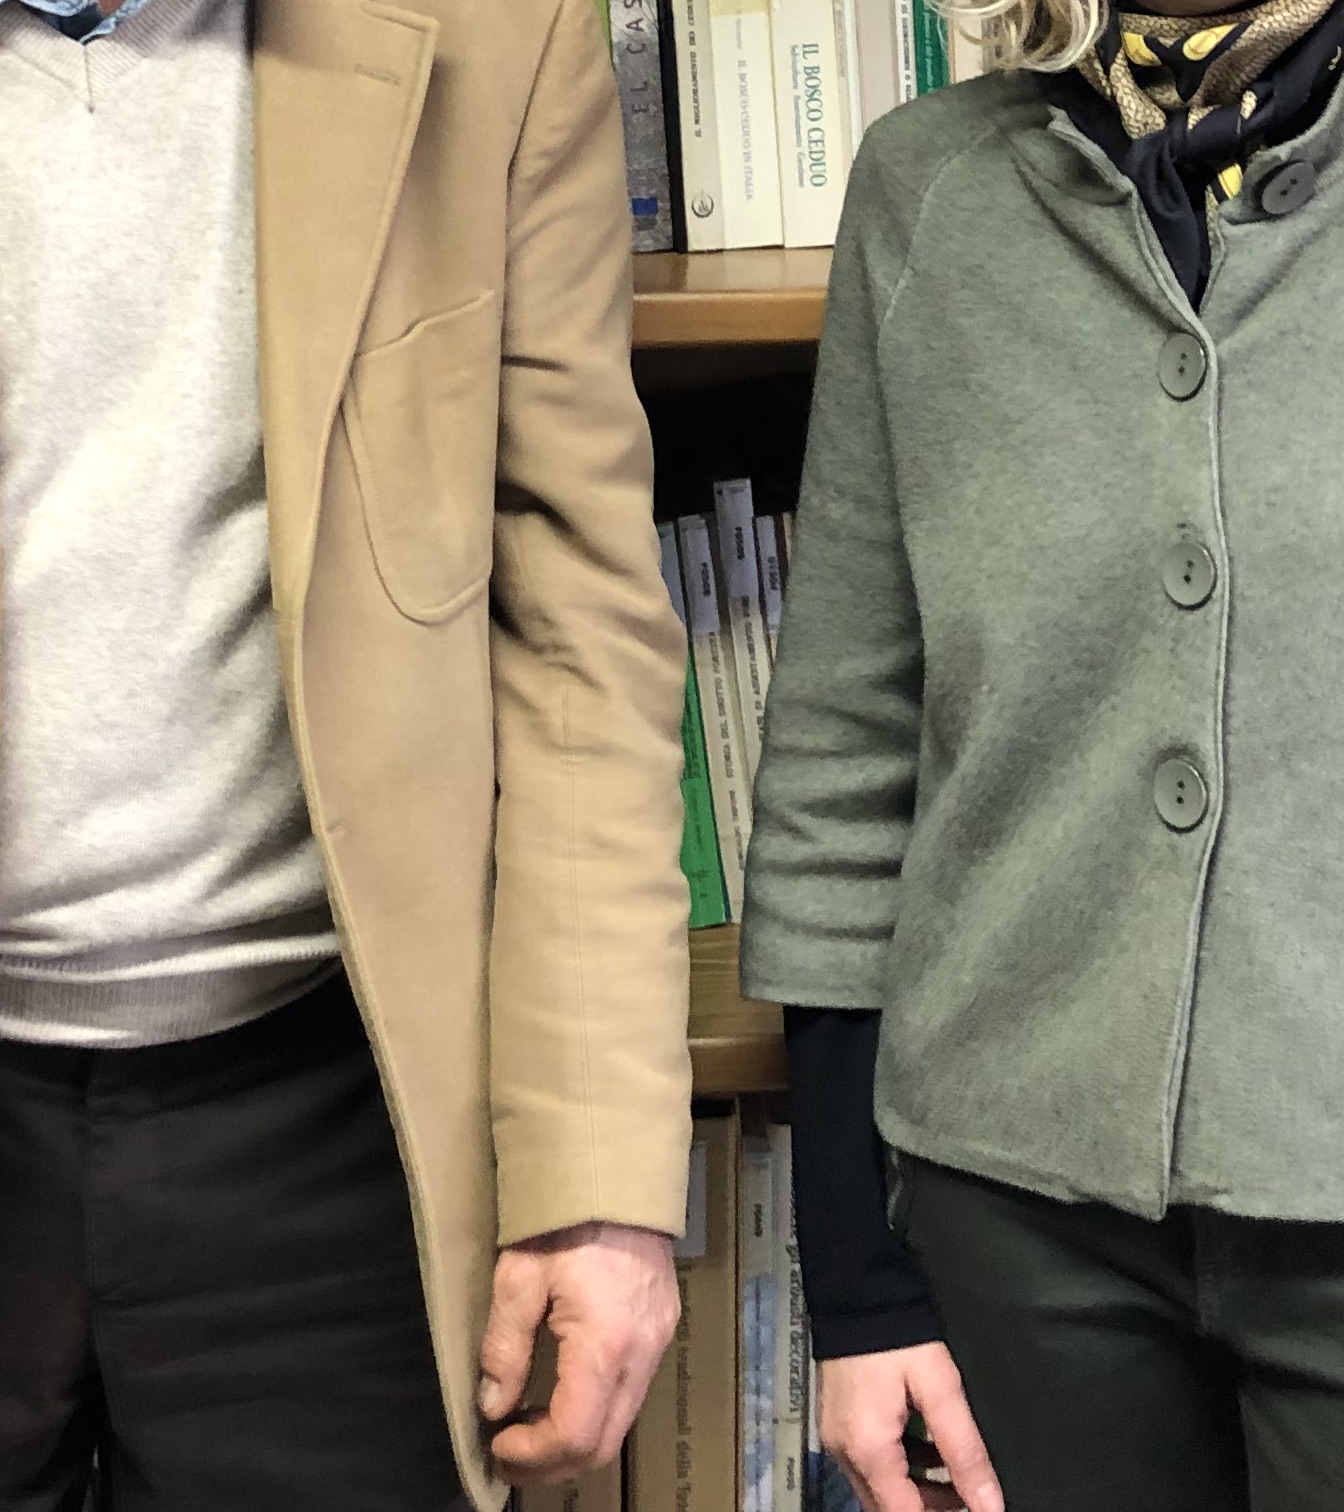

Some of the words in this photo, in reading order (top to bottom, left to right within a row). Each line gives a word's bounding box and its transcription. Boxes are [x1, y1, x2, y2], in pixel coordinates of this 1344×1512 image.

[801, 42, 819, 67] IL
[631, 79, 651, 116] EL
[804, 65, 825, 122] BOSCO
[806, 125, 829, 188] CEDUO
